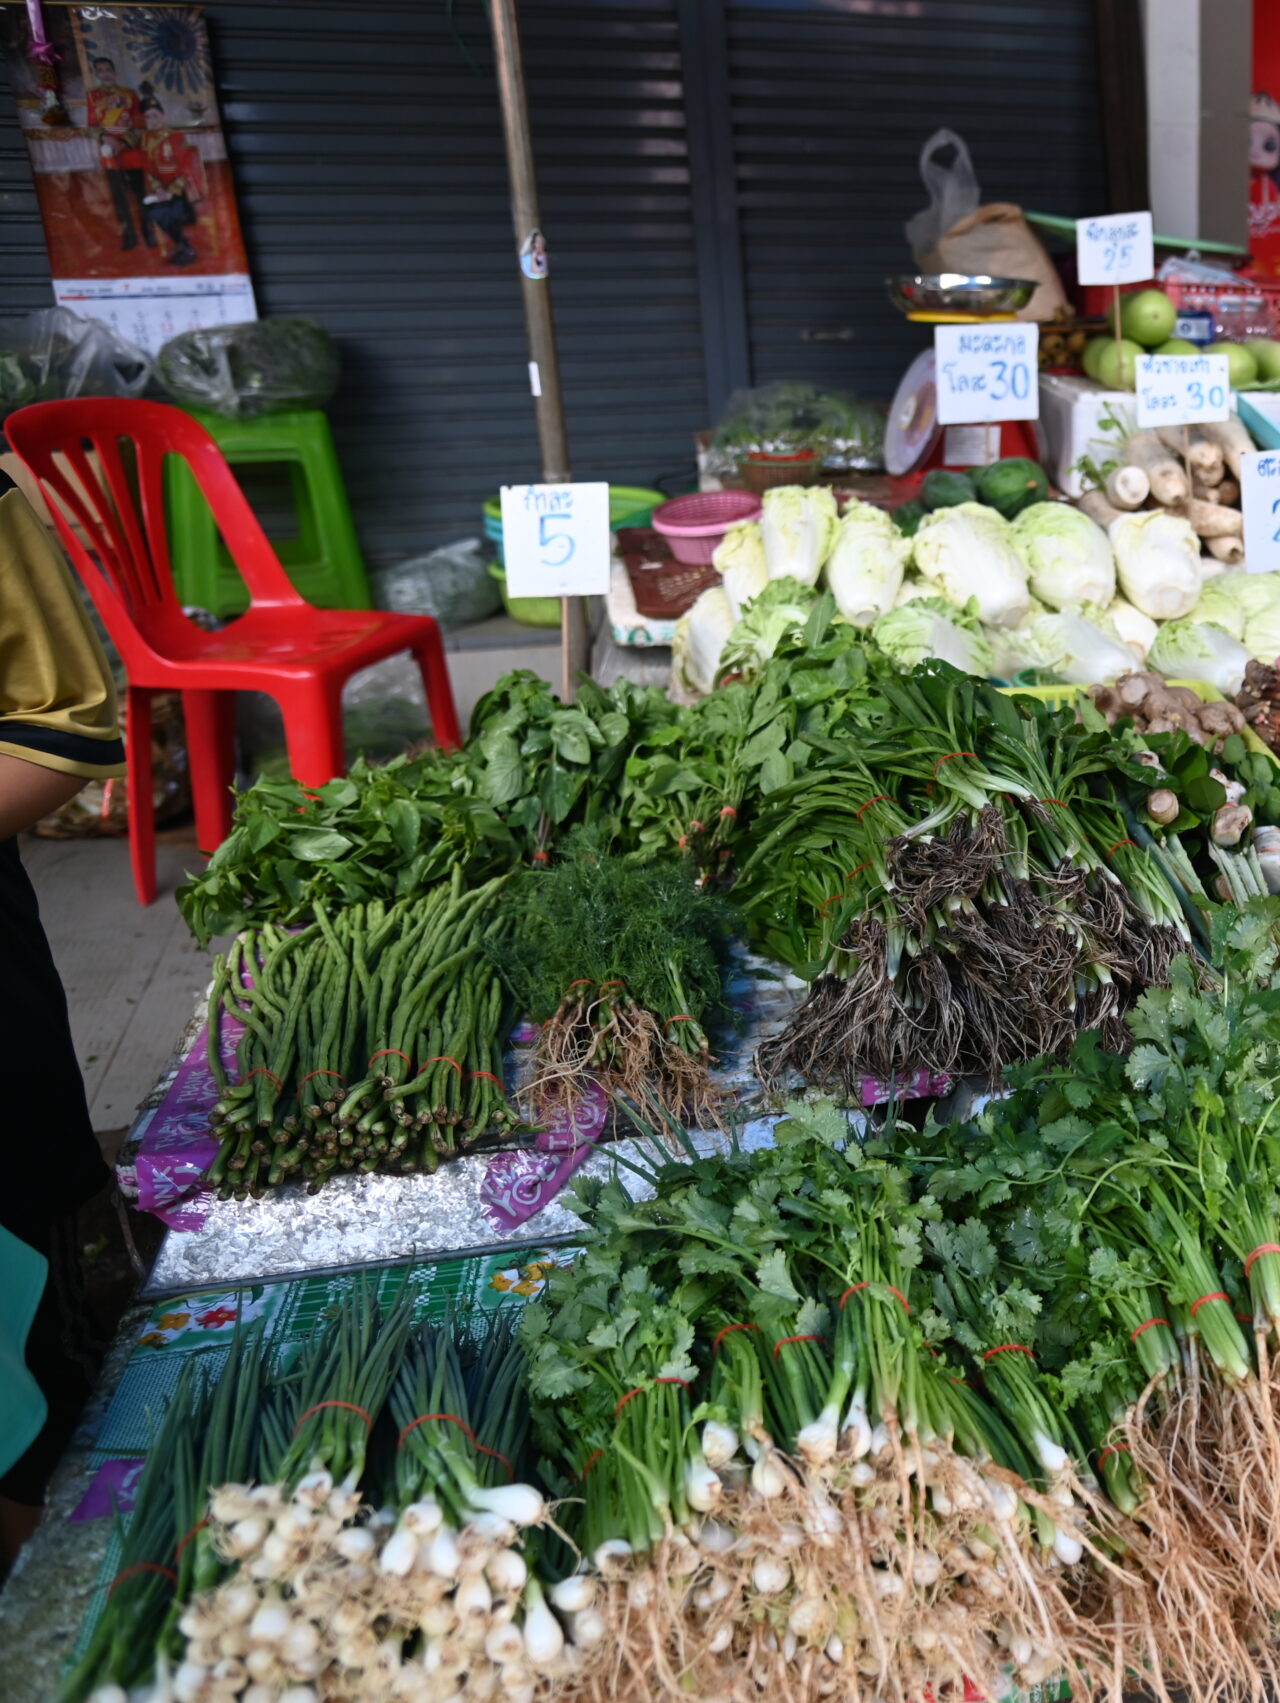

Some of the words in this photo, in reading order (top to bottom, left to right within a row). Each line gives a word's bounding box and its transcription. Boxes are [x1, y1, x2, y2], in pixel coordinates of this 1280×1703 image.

[1103, 245, 1134, 271] 25
[990, 360, 1029, 400] 30
[1186, 381, 1224, 410] 30
[524, 485, 574, 512] กำละ
[539, 513, 576, 567] 5
[176, 1069, 209, 1104] THANK
